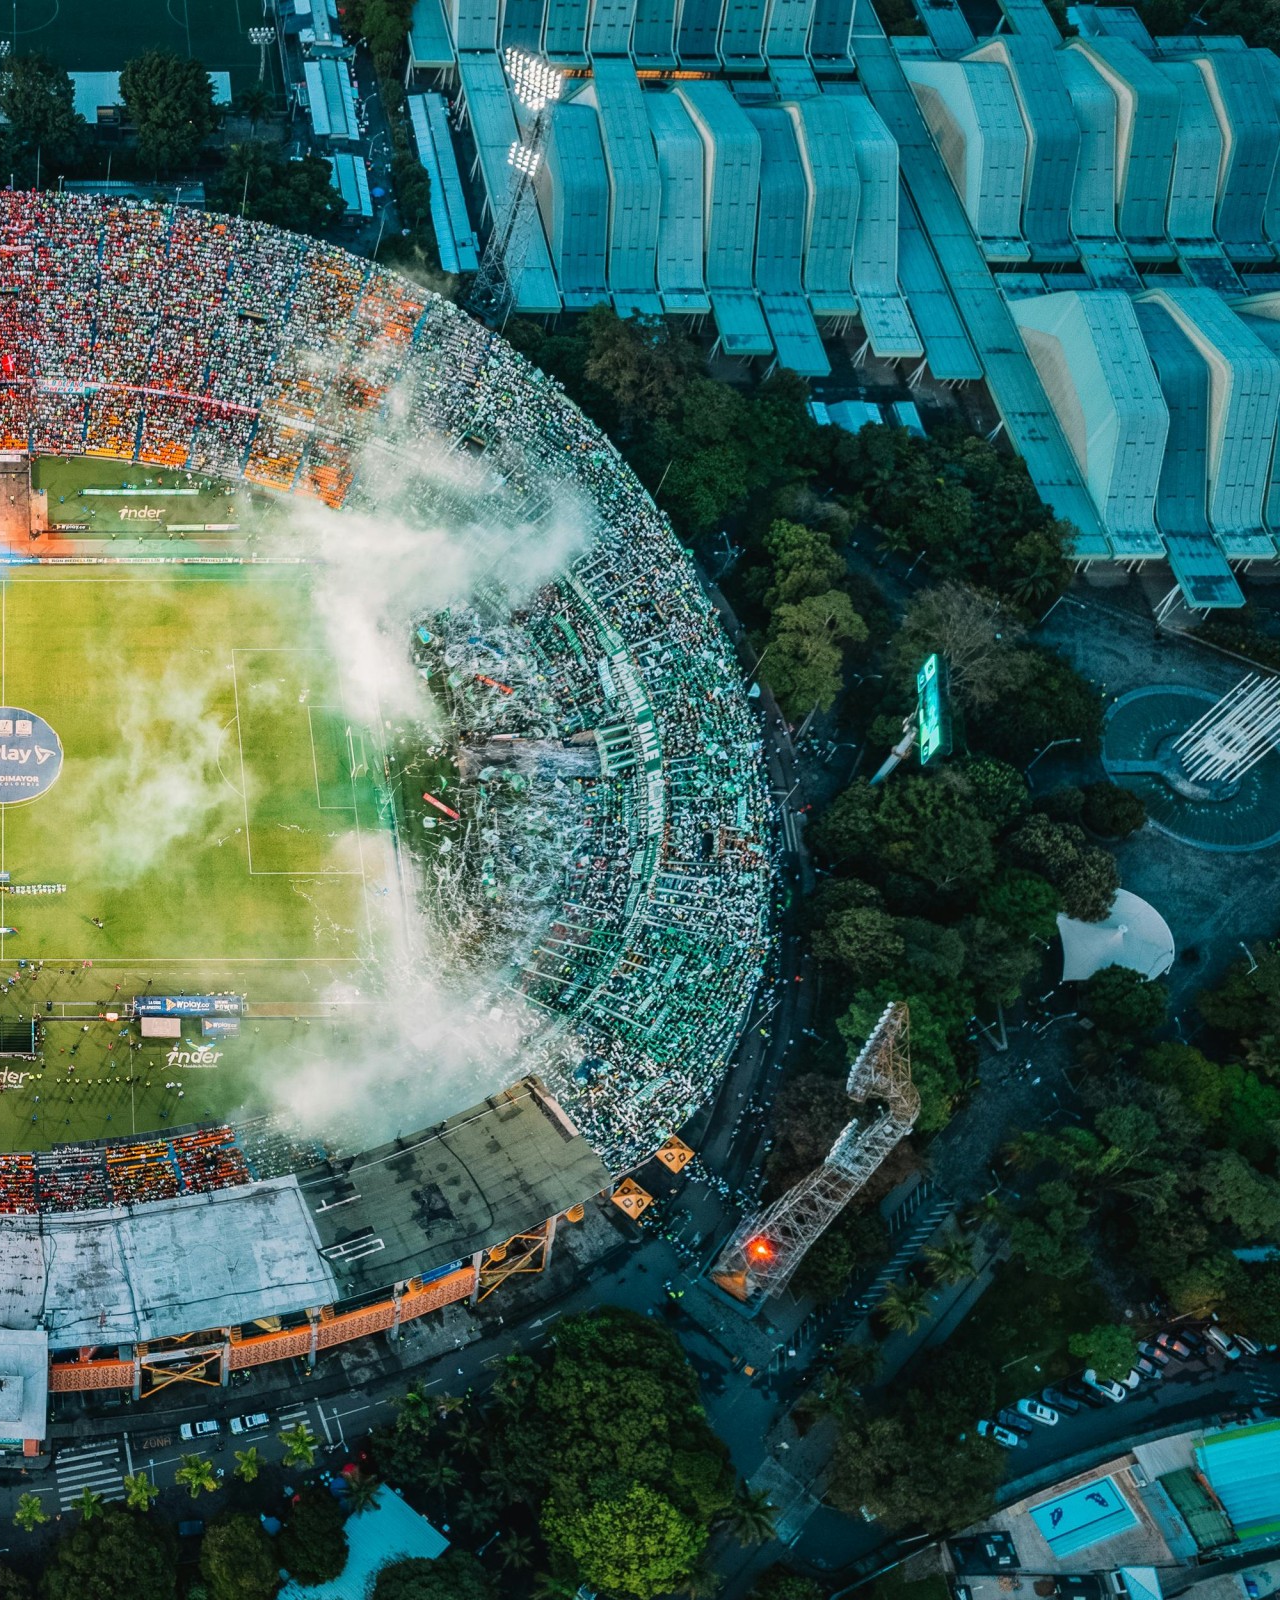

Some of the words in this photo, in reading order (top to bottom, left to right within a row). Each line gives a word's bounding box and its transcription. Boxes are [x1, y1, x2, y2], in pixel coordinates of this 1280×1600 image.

[118, 505, 166, 520] inder
[633, 720, 662, 762] DALE
[637, 769, 648, 831] PRESENTES
[166, 1046, 224, 1066] inder
